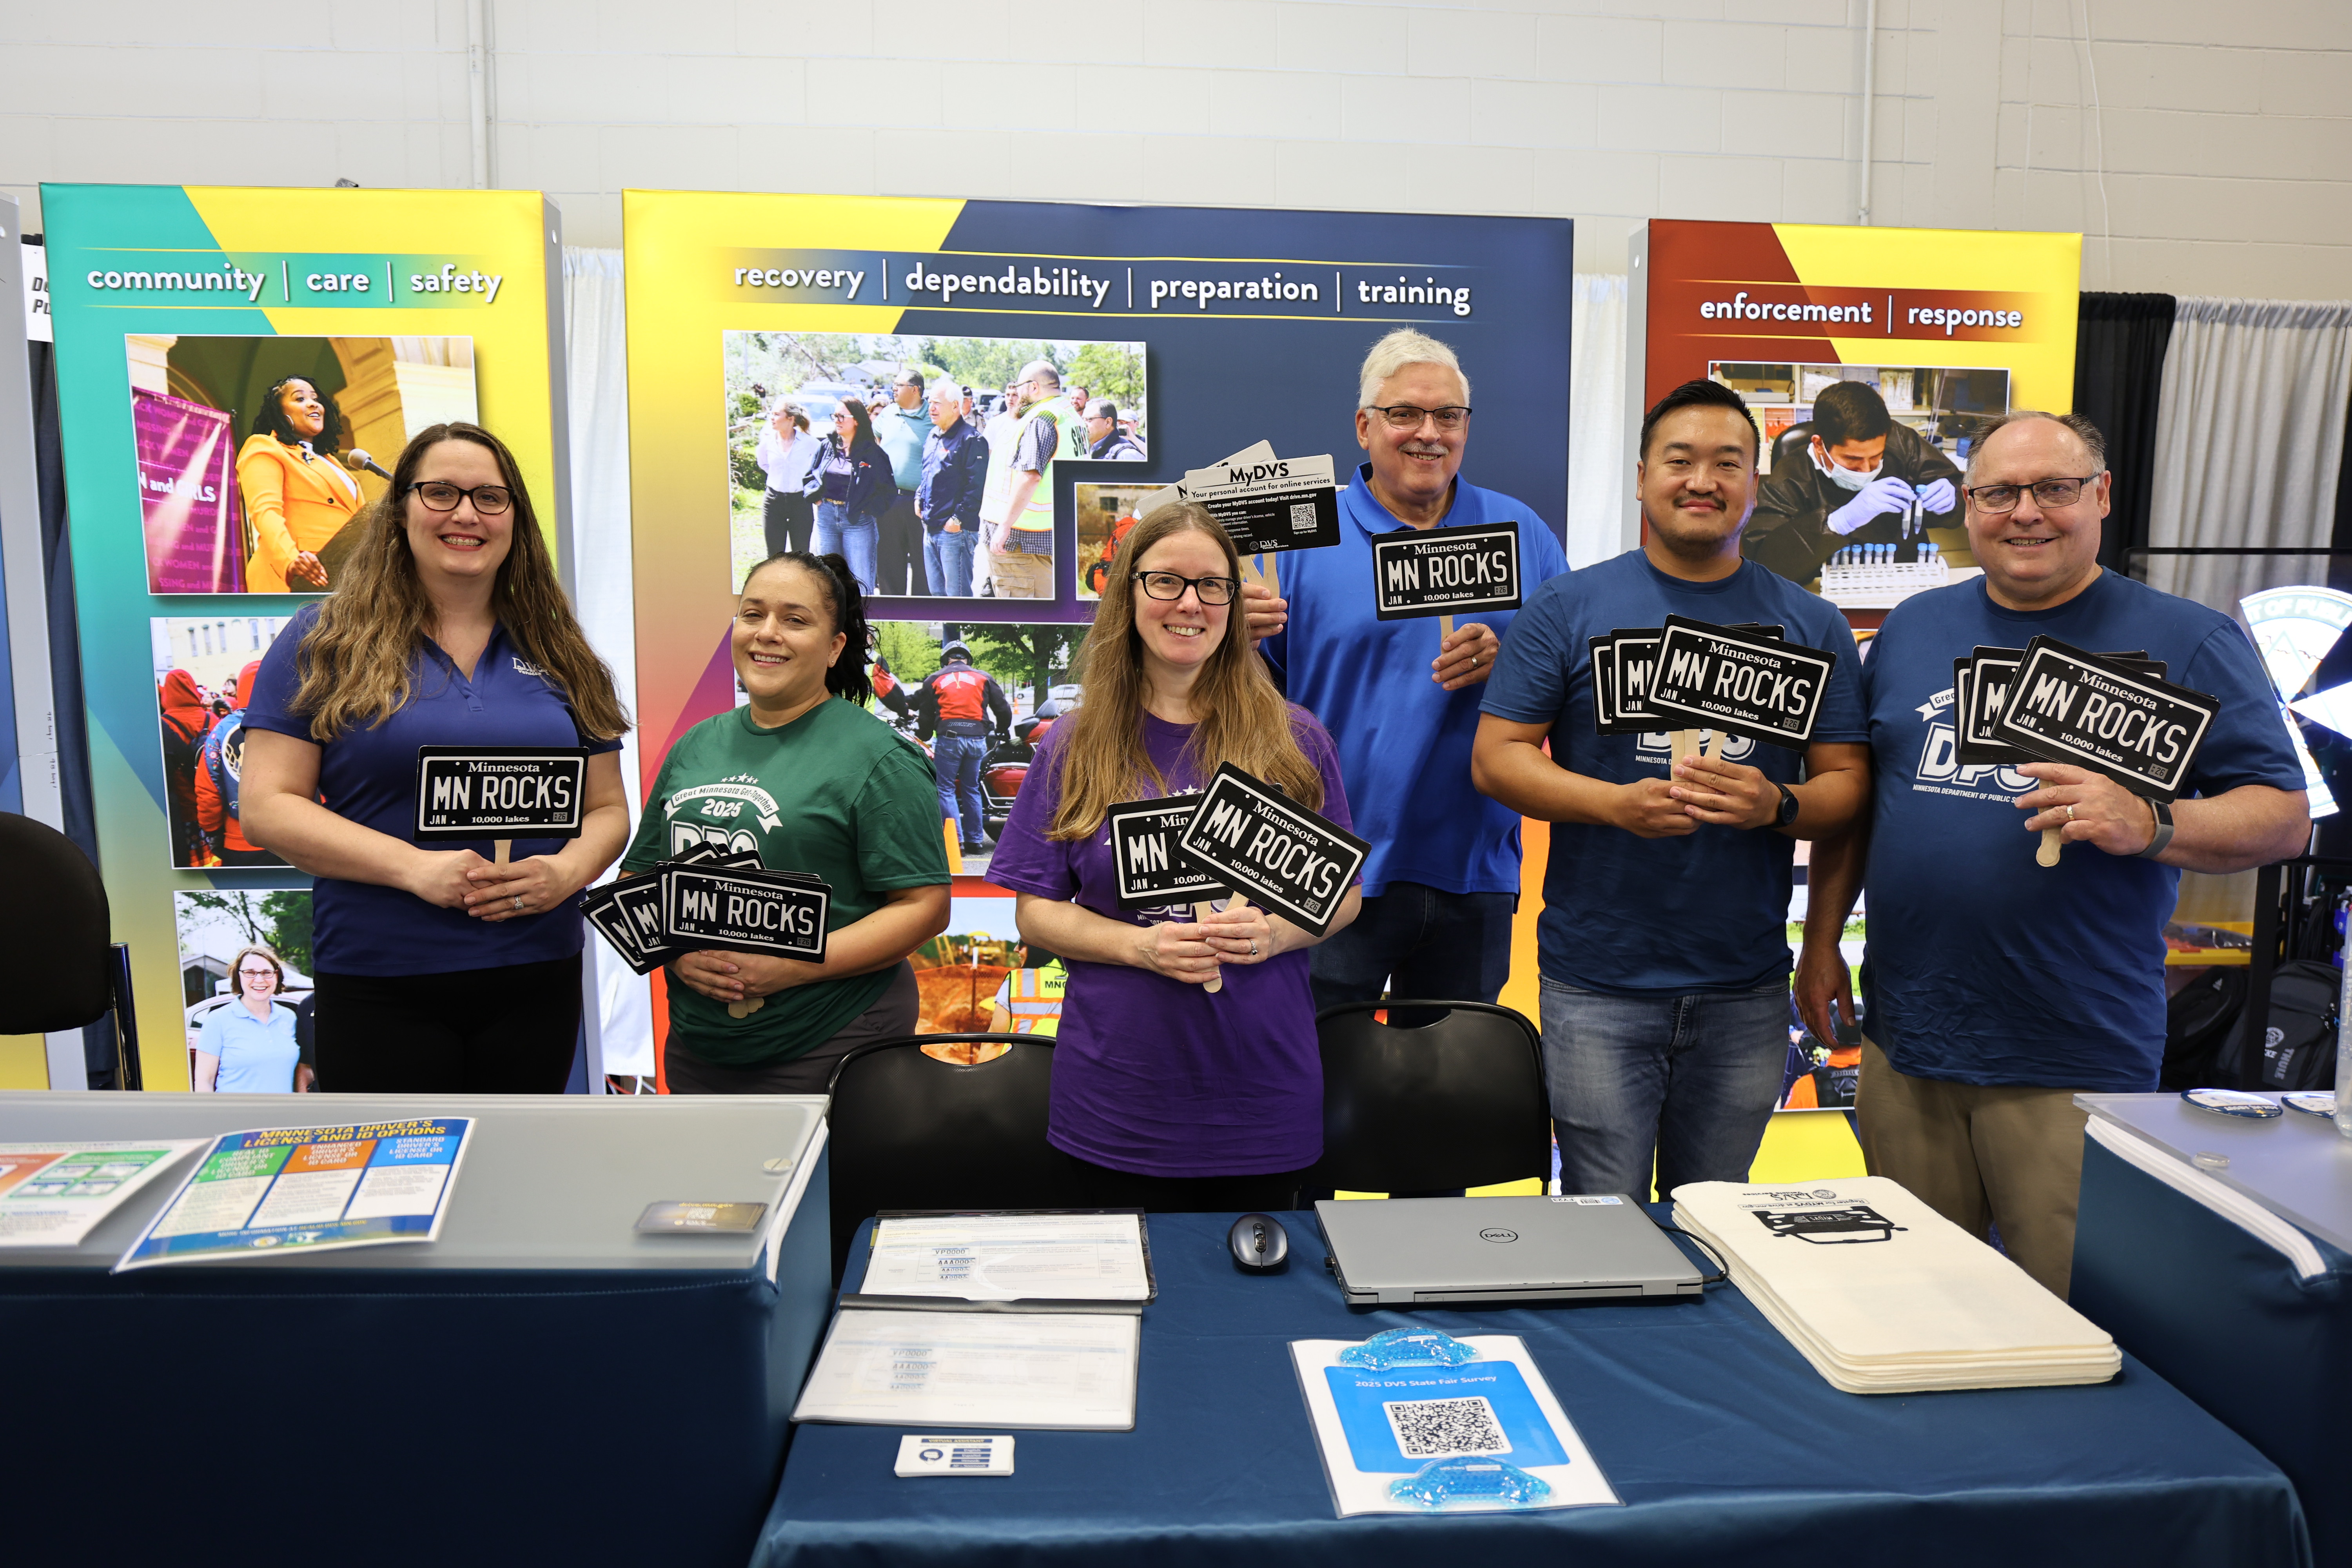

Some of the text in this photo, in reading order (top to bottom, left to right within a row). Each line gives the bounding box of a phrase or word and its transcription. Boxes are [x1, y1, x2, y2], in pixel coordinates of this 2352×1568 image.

[87, 263, 502, 303] community care safety
[735, 262, 1471, 316] recovery dependability preparation training
[1700, 292, 2023, 336] enforcement response
[1230, 463, 1289, 486] MyDVS
[150, 477, 216, 502] and GIRLS
[1209, 487, 1237, 498] personal
[1240, 485, 1266, 493] account
[1280, 481, 1301, 489] online
[1303, 478, 1330, 486] services
[1259, 539, 1278, 548] DVS
[1414, 542, 1477, 555] Minnesota
[1387, 551, 1507, 592] MN ROCKS
[1388, 595, 1402, 605] JAN
[1423, 593, 1450, 601] 10,000
[2264, 598, 2293, 616] OF
[1708, 641, 1781, 669] Minnesota
[1666, 648, 1811, 716] MN ROCKS
[2078, 670, 2157, 710] Minnesota
[1660, 688, 1678, 701] JAN
[1626, 701, 1642, 711] JAN
[1700, 700, 1759, 720] 10,000 lakes
[1789, 720, 1797, 728] 26
[2016, 713, 2037, 729] JAN
[2025, 673, 2187, 763] MN ROCKS
[2059, 732, 2123, 763] 10,000 lakes
[468, 762, 540, 772] Minnesota
[1635, 755, 1667, 765] MINNESOTA
[2156, 766, 2165, 777] 26
[433, 776, 571, 810] MN ROCKS
[675, 789, 696, 801] Great
[740, 788, 772, 813] Get-Together
[1913, 784, 1940, 793] MINNESOTA
[1941, 787, 1979, 799] DEPARTMENT
[1987, 794, 2010, 802] PUBLIC
[700, 799, 744, 817] 2025
[430, 815, 446, 824] JAN
[1252, 800, 1319, 846] Minnesota
[1128, 833, 1168, 874] MN
[1193, 837, 1212, 853] JAN
[1203, 798, 1252, 849] MN
[1245, 822, 1341, 898] ROCKS
[1131, 878, 1148, 891] JAN
[1173, 875, 1206, 884] 10,000
[1229, 859, 1284, 894] 10,000 lakes
[715, 881, 783, 900] Minnesota
[682, 889, 814, 935] MN ROCKS
[1309, 902, 1318, 911] 26
[679, 922, 695, 931] JAN
[718, 929, 774, 941] 10,000 lakes
[2275, 1048, 2294, 1080] THULE
[244, 1136, 314, 1148] LICENSE
[317, 1133, 353, 1142] AND
[377, 1127, 446, 1138] OPTIONS
[260, 1120, 434, 1138] MINNESOTA DRIVER'S
[311, 1142, 363, 1150] ENHANCED
[303, 1153, 343, 1161] LICENSE
